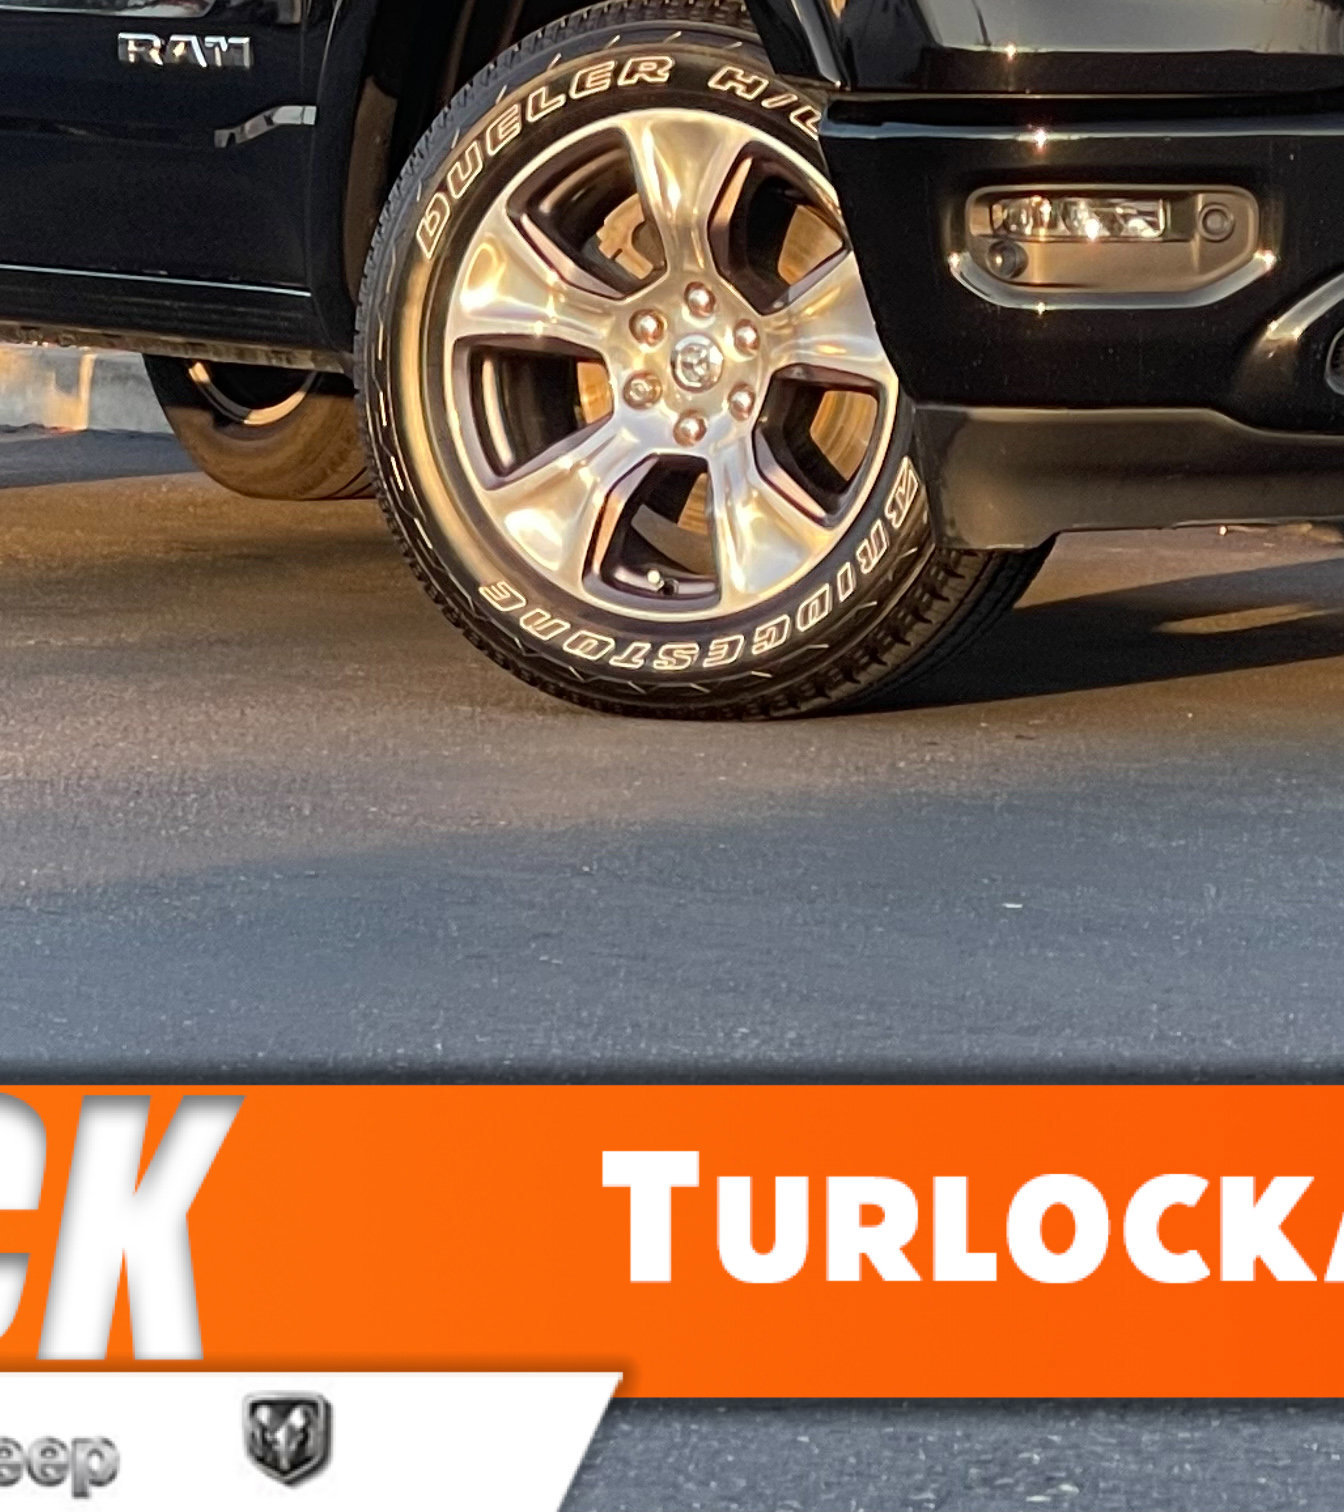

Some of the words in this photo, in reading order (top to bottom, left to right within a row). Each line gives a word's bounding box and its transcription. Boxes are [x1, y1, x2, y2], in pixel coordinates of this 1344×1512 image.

[117, 32, 253, 70] RAM
[415, 54, 675, 260] DUELER
[478, 456, 919, 672] BRIDGESTONE
